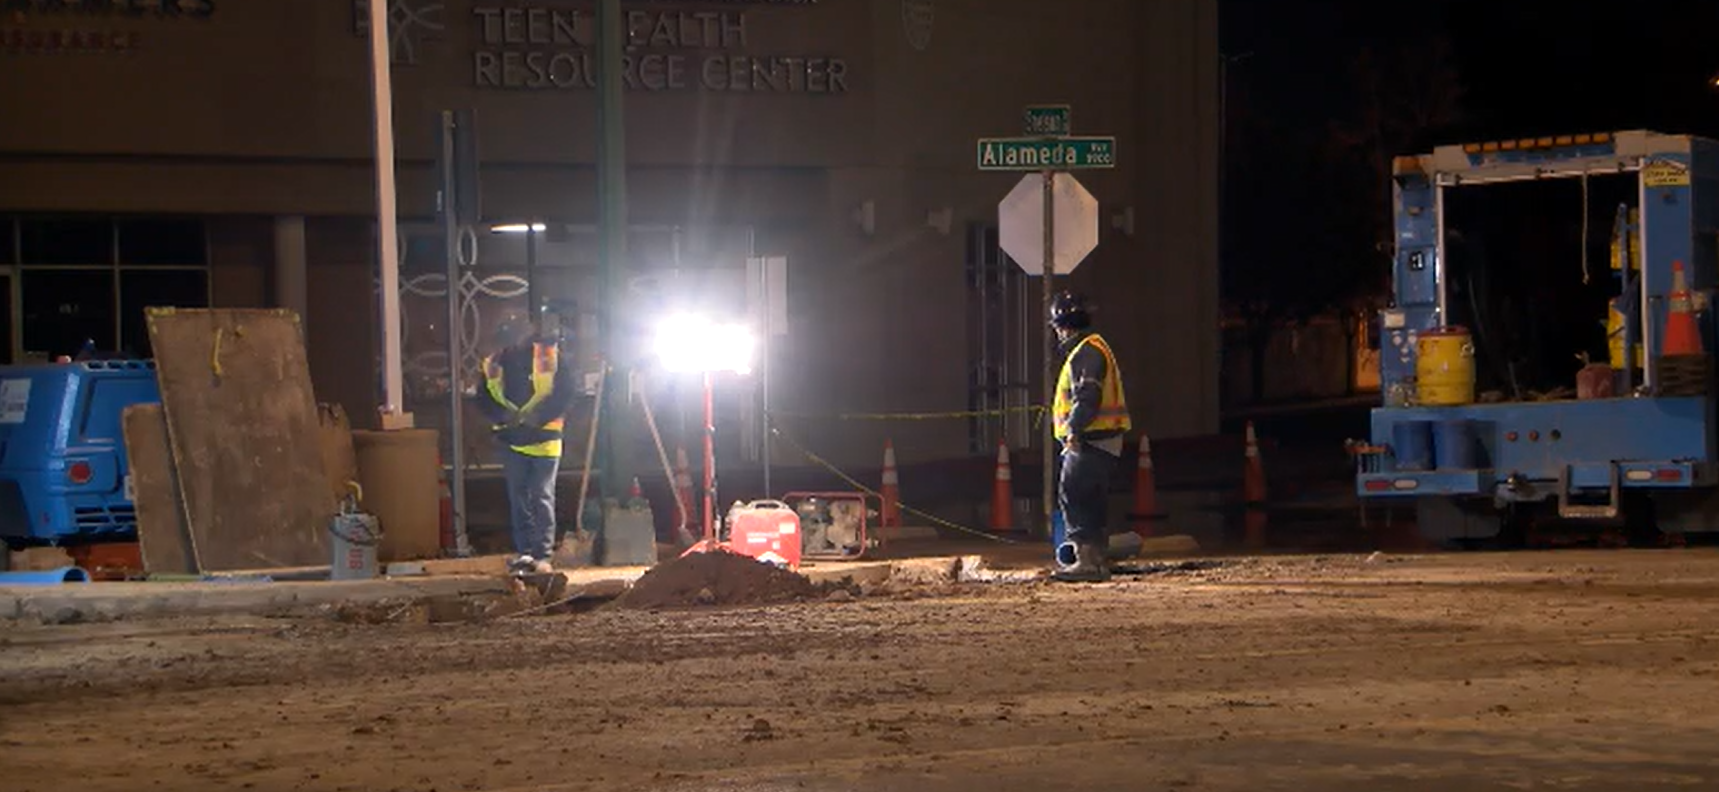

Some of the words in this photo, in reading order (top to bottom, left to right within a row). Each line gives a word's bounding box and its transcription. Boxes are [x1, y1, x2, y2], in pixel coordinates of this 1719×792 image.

[473, 8, 580, 47] TEEN
[627, 10, 747, 48] EALTH
[701, 56, 849, 93] CENTER
[982, 142, 1077, 165] Alameda
